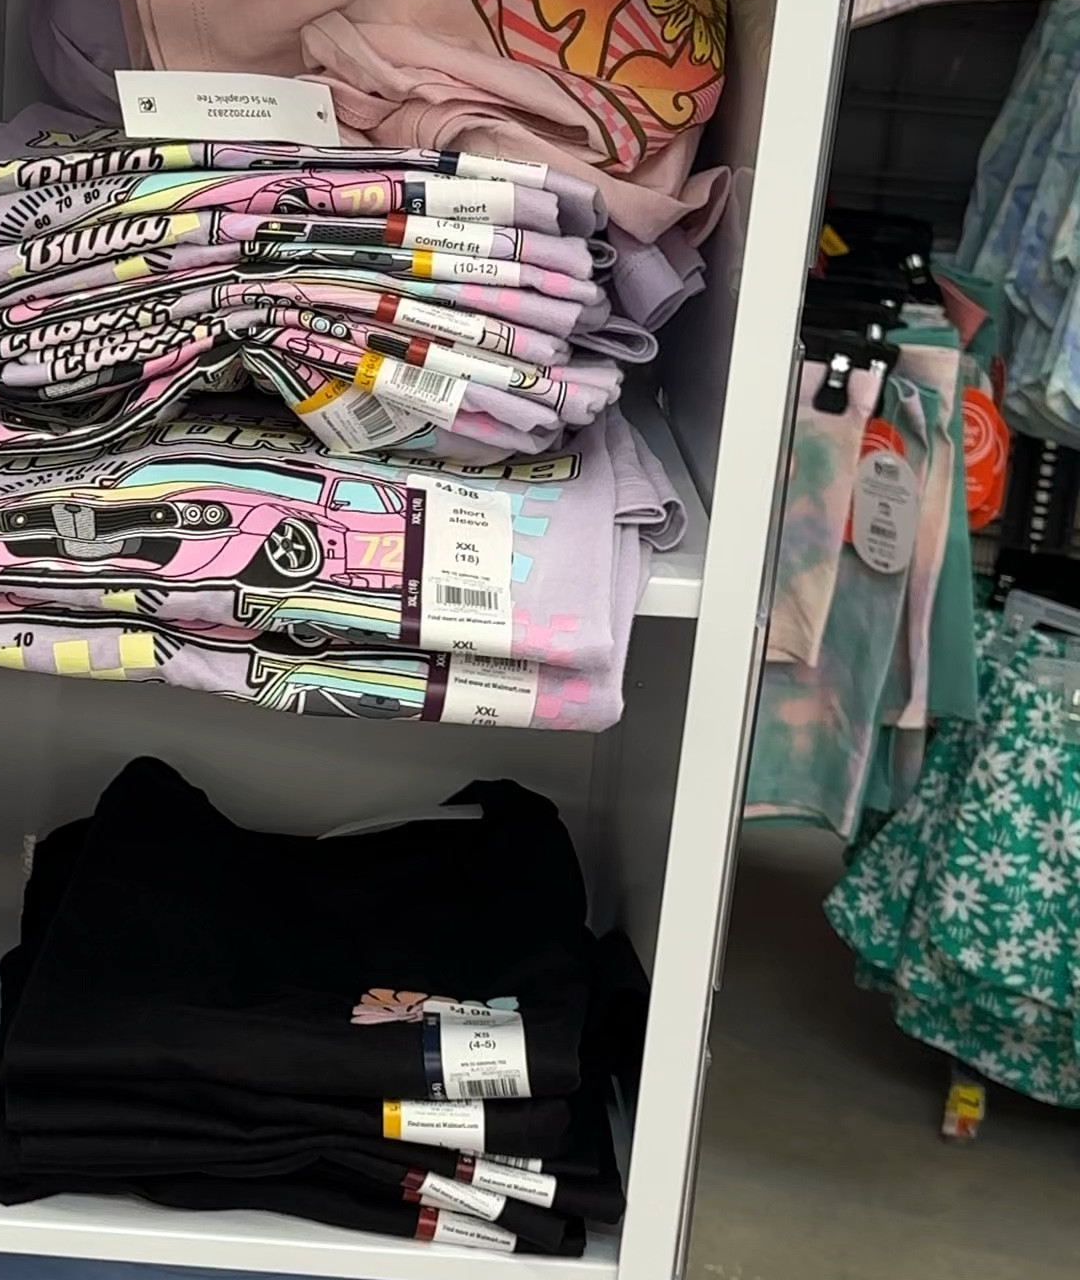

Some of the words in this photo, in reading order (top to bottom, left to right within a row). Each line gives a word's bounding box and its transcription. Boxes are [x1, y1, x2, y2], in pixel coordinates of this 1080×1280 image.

[196, 94, 213, 104] Tee
[215, 94, 250, 105] Graphic
[83, 188, 102, 205] 80
[56, 195, 73, 213] 70
[452, 203, 487, 214] short
[34, 213, 52, 230] 60
[415, 235, 465, 251] comfort
[466, 242, 481, 254] fit
[453, 262, 499, 276] (10-12)
[402, 313, 415, 325] Find
[415, 318, 430, 330] more
[437, 324, 476, 340] Walmart.com
[435, 481, 480, 500] $4.98
[452, 507, 487, 519] short
[449, 516, 489, 528] sleeve
[354, 535, 404, 570] 72
[455, 541, 480, 553] XXL
[454, 552, 480, 566] (18)
[13, 632, 34, 648] 10
[452, 640, 478, 651] XXL
[454, 676, 468, 685] Find
[469, 679, 484, 688] more
[492, 681, 531, 694] Walmart.com
[475, 705, 499, 718] XXL
[468, 1040, 497, 1051] (4-5)
[408, 1120, 420, 1128] Find
[419, 1121, 435, 1129] more
[442, 1121, 479, 1130] Walmart.com
[479, 1175, 491, 1184] Find
[491, 1179, 506, 1188] more
[513, 1184, 549, 1198] Walmart.com
[443, 1224, 454, 1232] Find
[455, 1227, 469, 1236] more
[476, 1232, 511, 1246] Walmart.com
